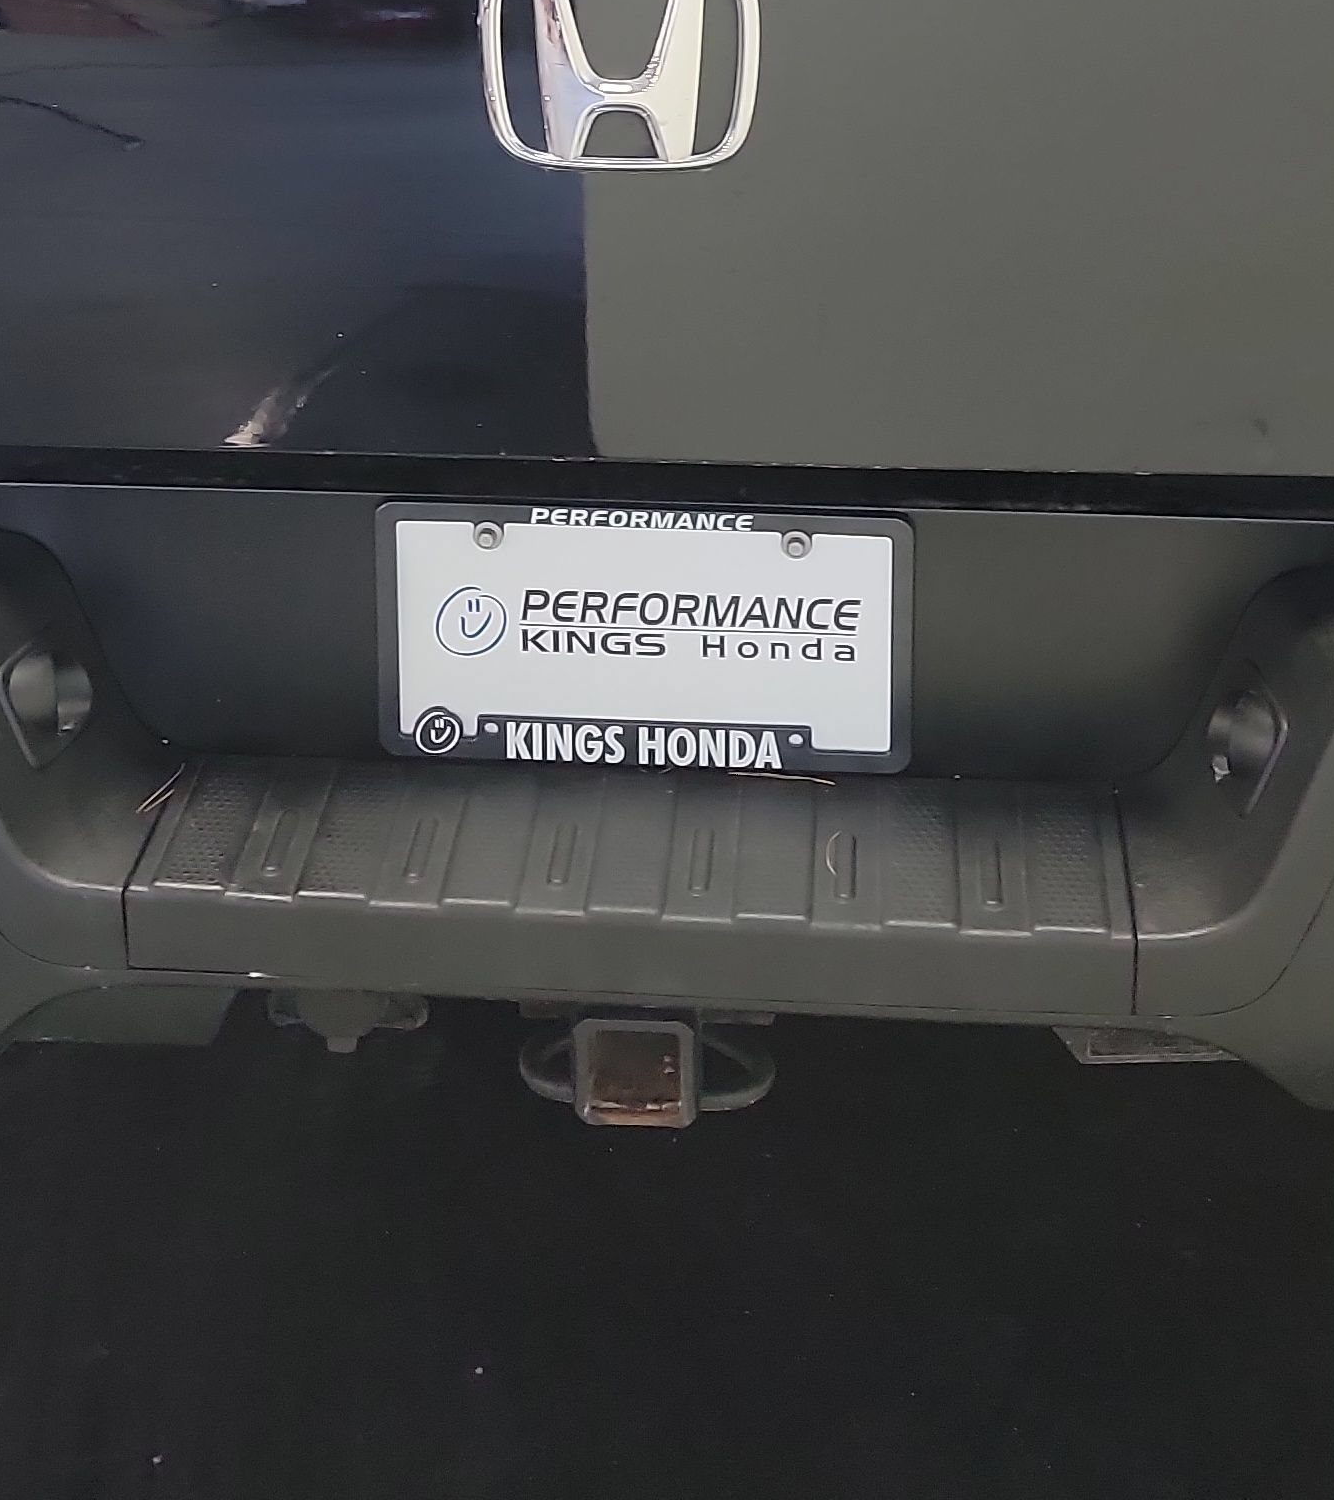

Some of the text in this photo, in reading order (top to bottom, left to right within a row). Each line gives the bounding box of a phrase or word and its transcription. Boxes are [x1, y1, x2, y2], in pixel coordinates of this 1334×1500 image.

[529, 507, 755, 532] PERFORMANCE
[520, 589, 861, 632] PERFORMANCE
[520, 630, 857, 662] KINGS Honda
[505, 722, 783, 769] KINGS HONDA
